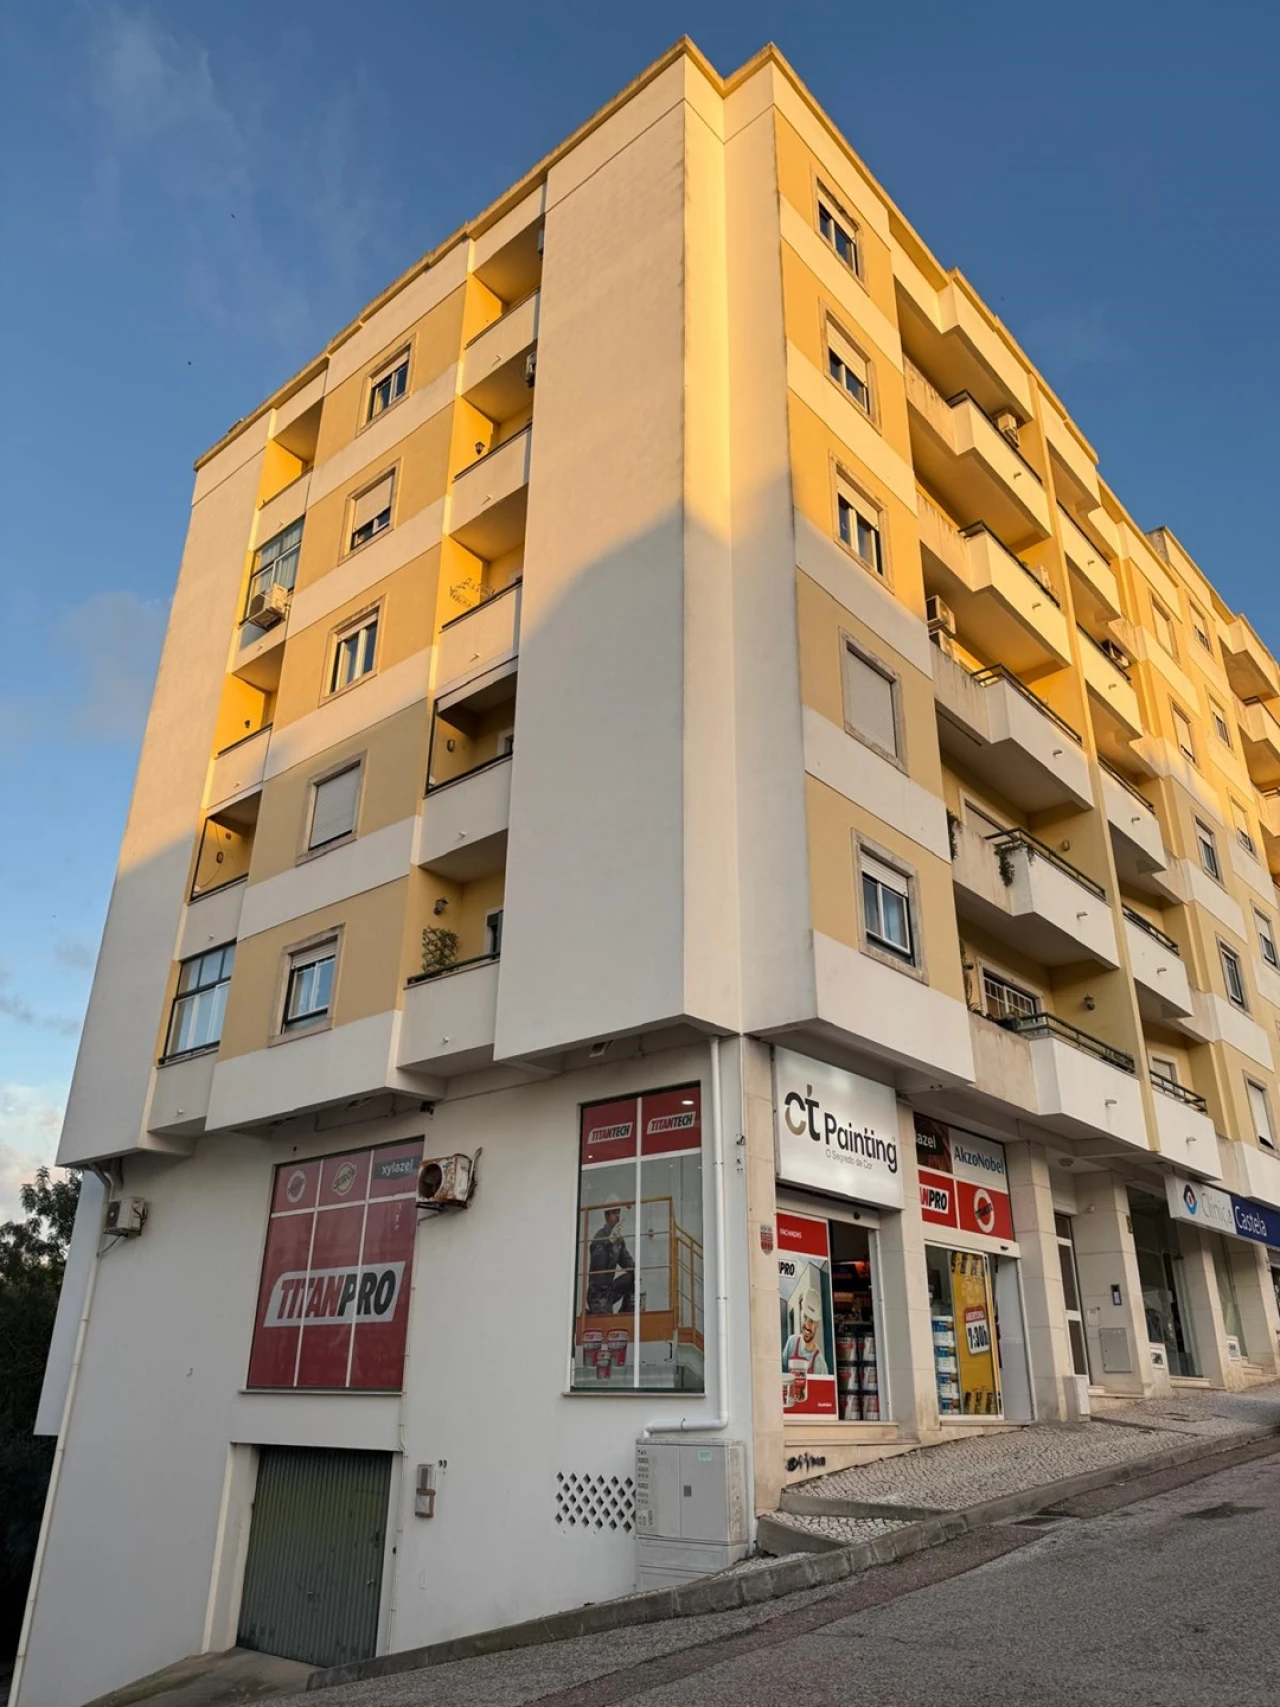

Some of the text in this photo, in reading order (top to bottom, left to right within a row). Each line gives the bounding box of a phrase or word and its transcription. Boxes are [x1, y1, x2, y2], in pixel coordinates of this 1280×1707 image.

[591, 1123, 630, 1140] TITANTECH
[651, 1113, 694, 1132] TITANTECH
[824, 1112, 898, 1174] Painting
[381, 1158, 414, 1176] xylazel
[954, 1145, 1005, 1175] AkzoNobel
[1235, 1205, 1268, 1237] Castela
[277, 1269, 395, 1319] TITANPRO
